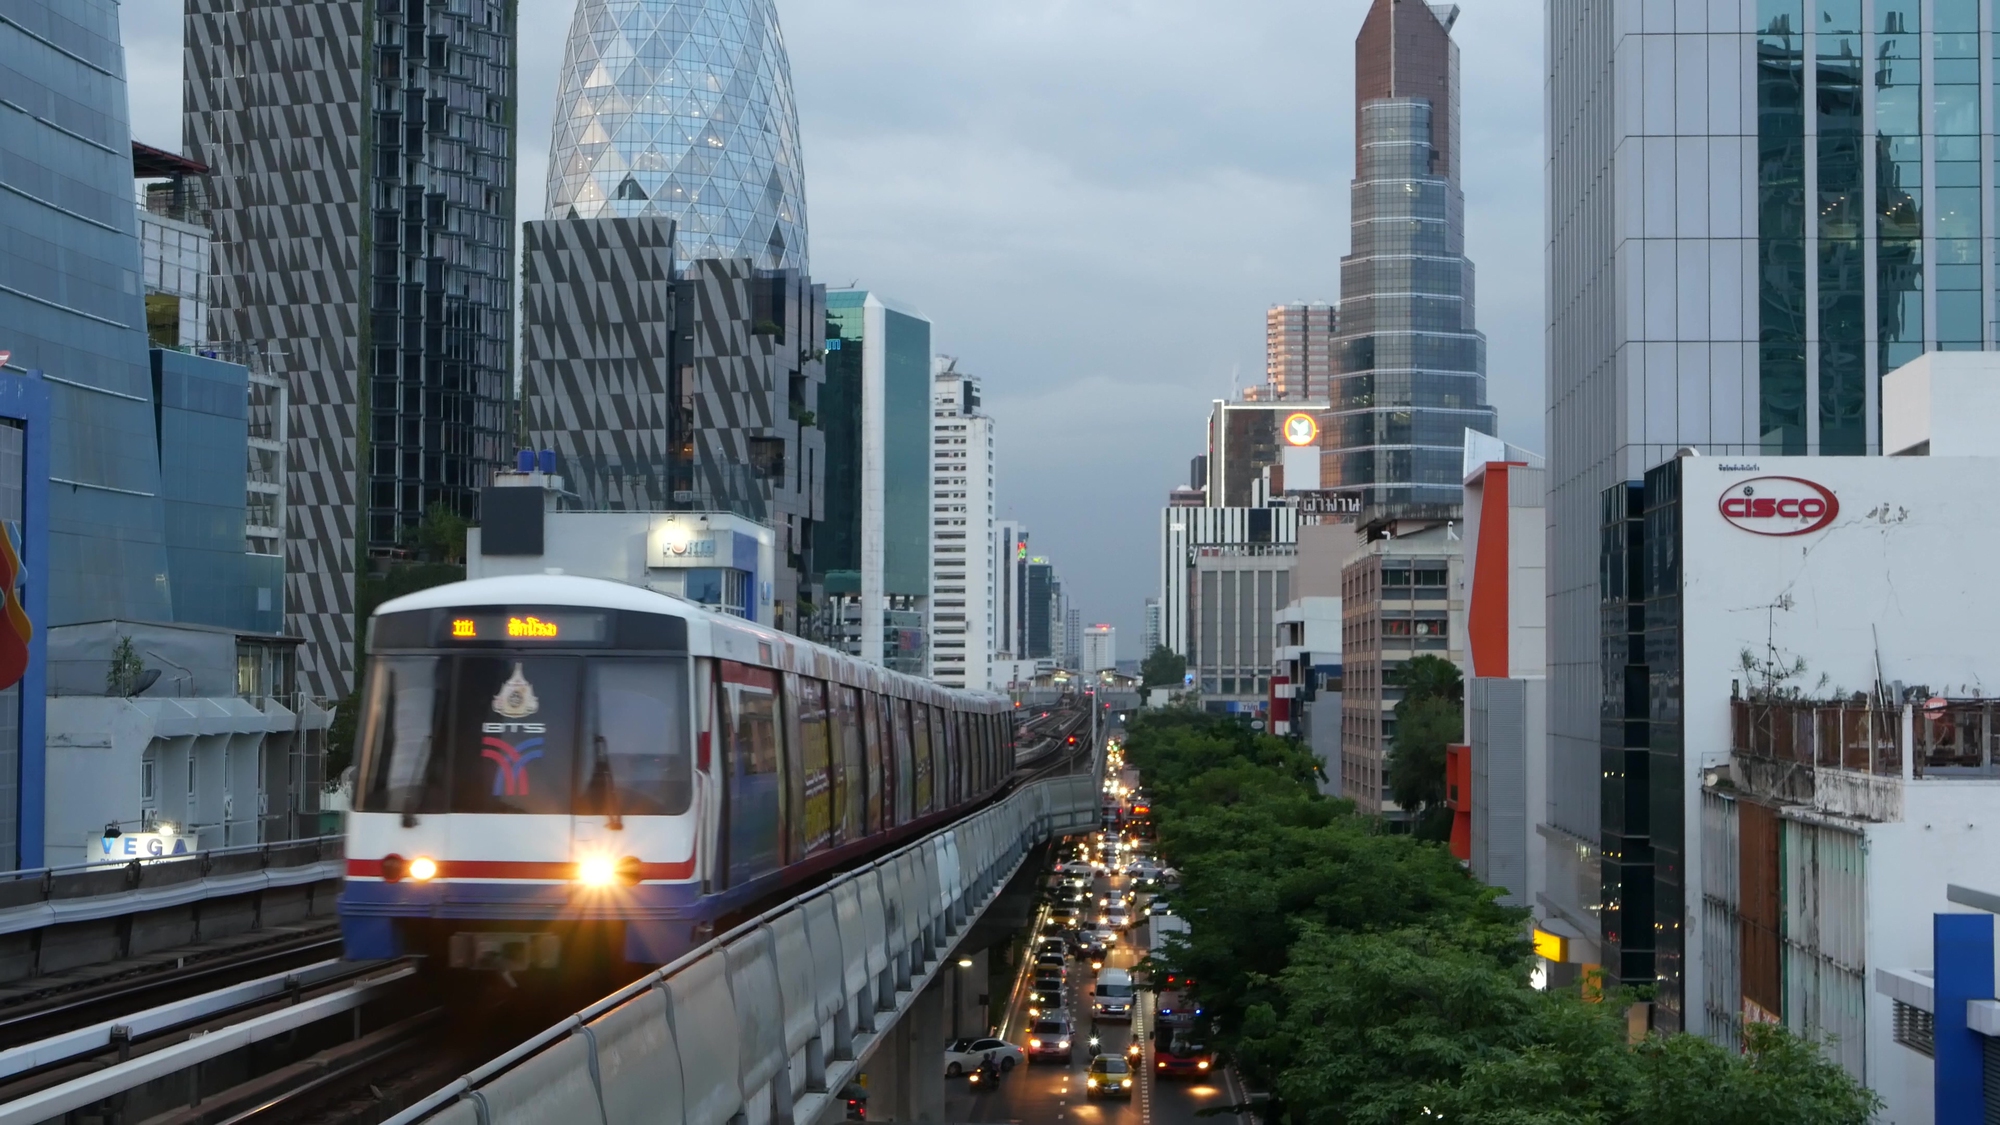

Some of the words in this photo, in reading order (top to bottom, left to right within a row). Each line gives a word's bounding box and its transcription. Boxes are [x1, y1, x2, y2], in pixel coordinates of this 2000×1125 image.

[1303, 492, 1361, 512] ผ้าม่าน
[482, 722, 547, 734] BTS
[100, 837, 188, 857] VEGA
